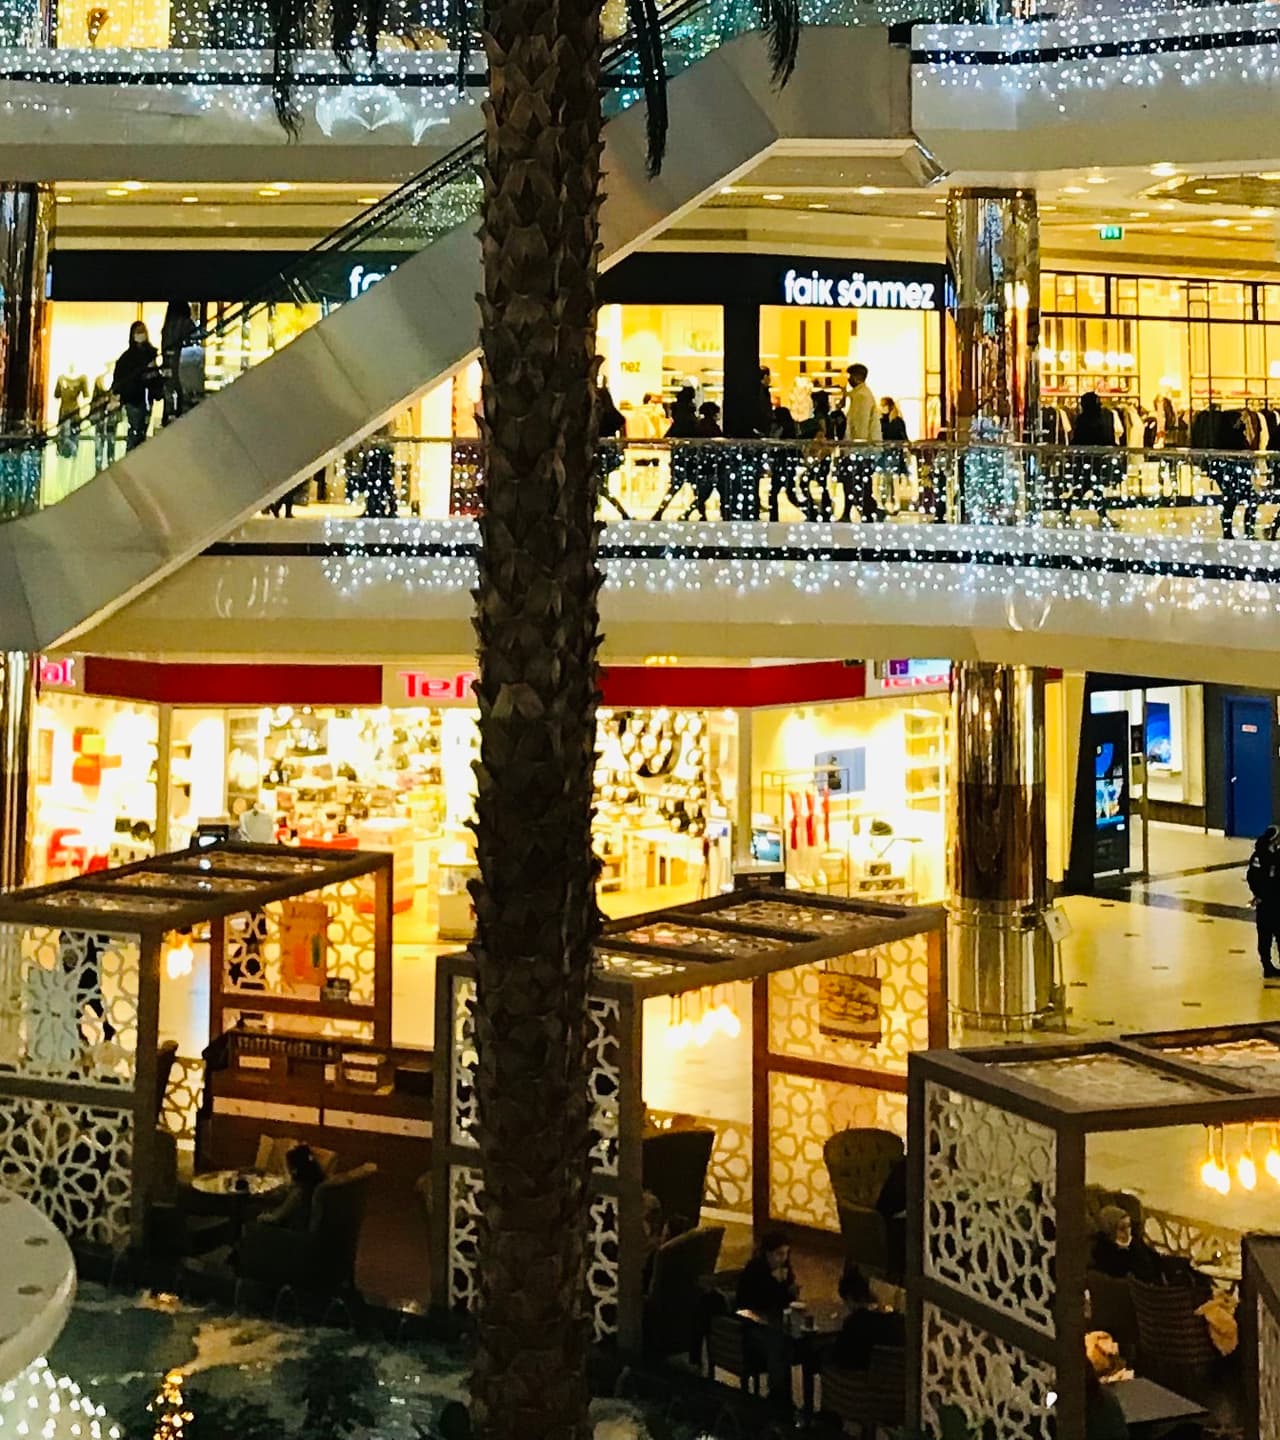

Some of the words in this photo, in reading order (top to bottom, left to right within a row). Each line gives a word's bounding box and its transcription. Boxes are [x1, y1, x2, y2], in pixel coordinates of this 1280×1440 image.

[784, 269, 834, 305] faik
[837, 272, 936, 309] sönmez
[397, 670, 477, 699] Tef
